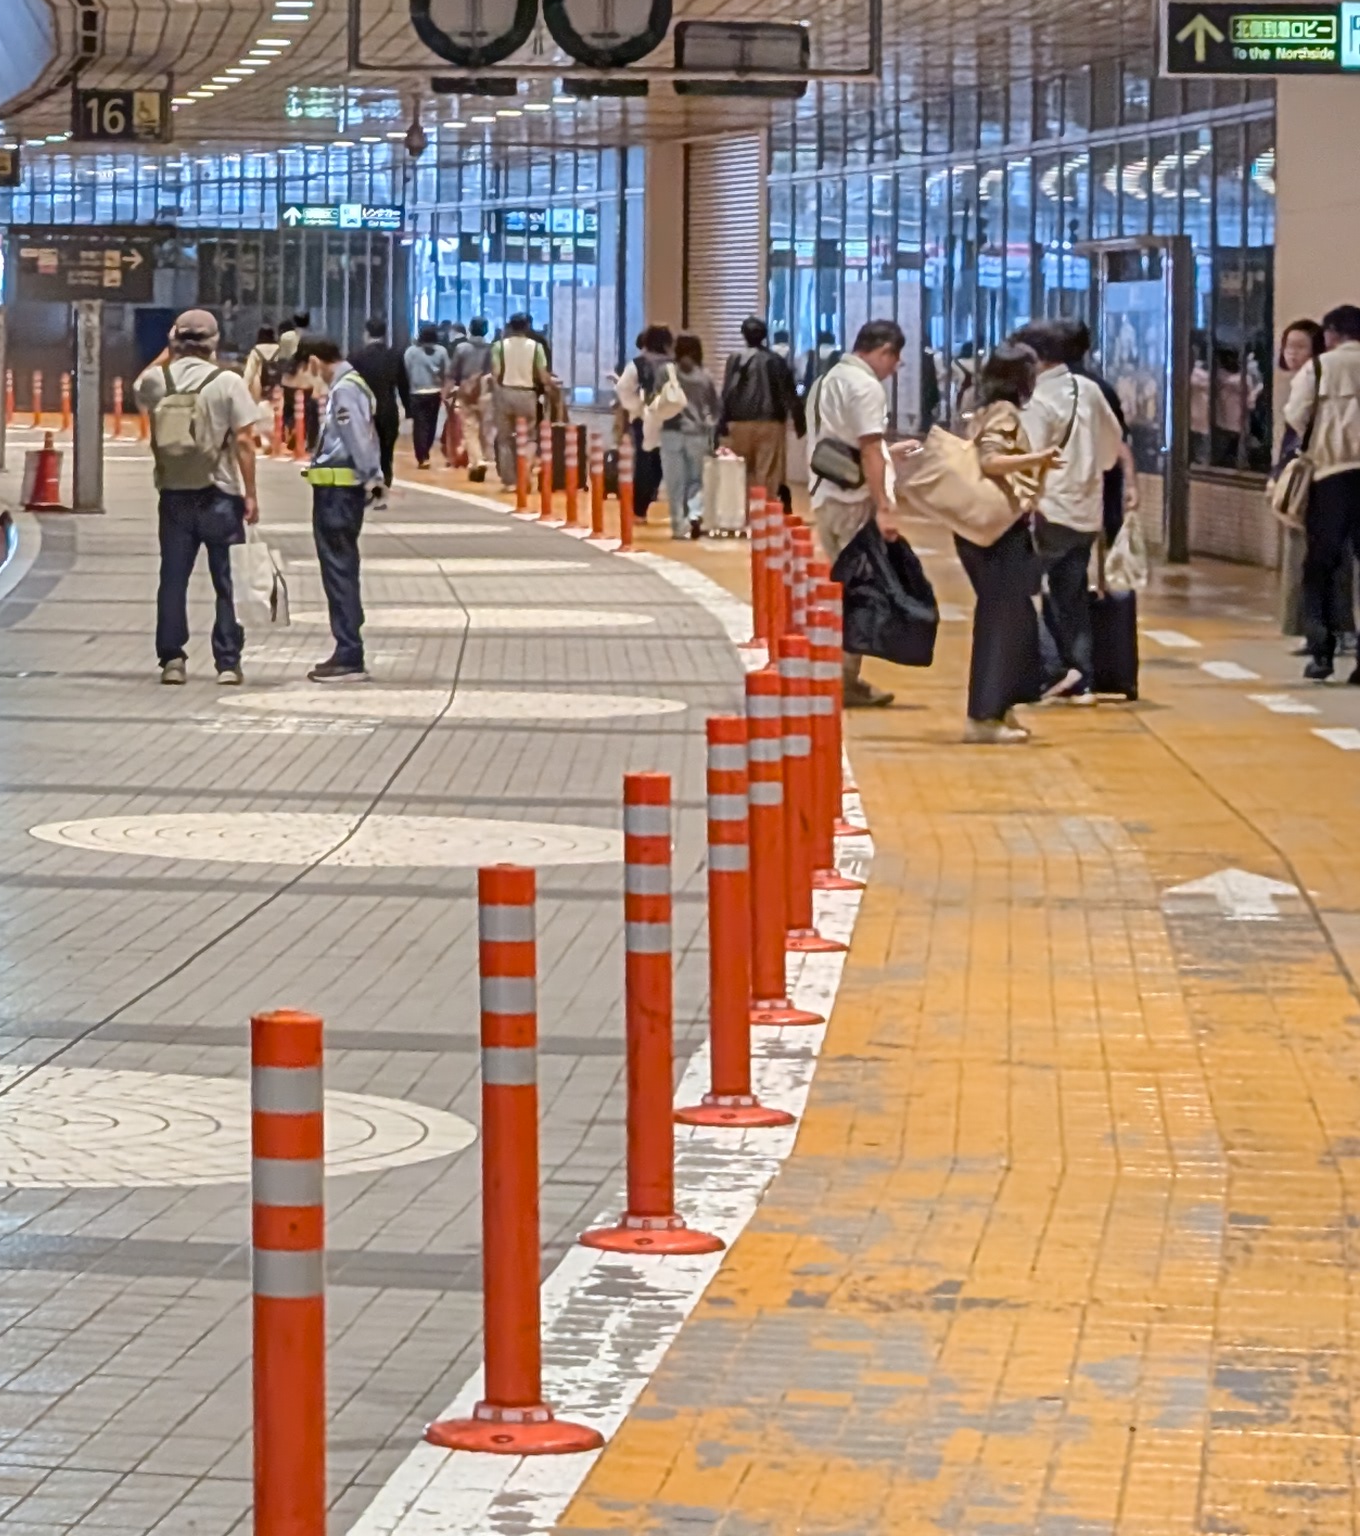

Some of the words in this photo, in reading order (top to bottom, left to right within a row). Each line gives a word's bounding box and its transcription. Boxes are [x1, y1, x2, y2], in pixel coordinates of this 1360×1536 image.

[1233, 47, 1247, 60] To
[1249, 47, 1271, 60] the
[86, 97, 125, 134] 16
